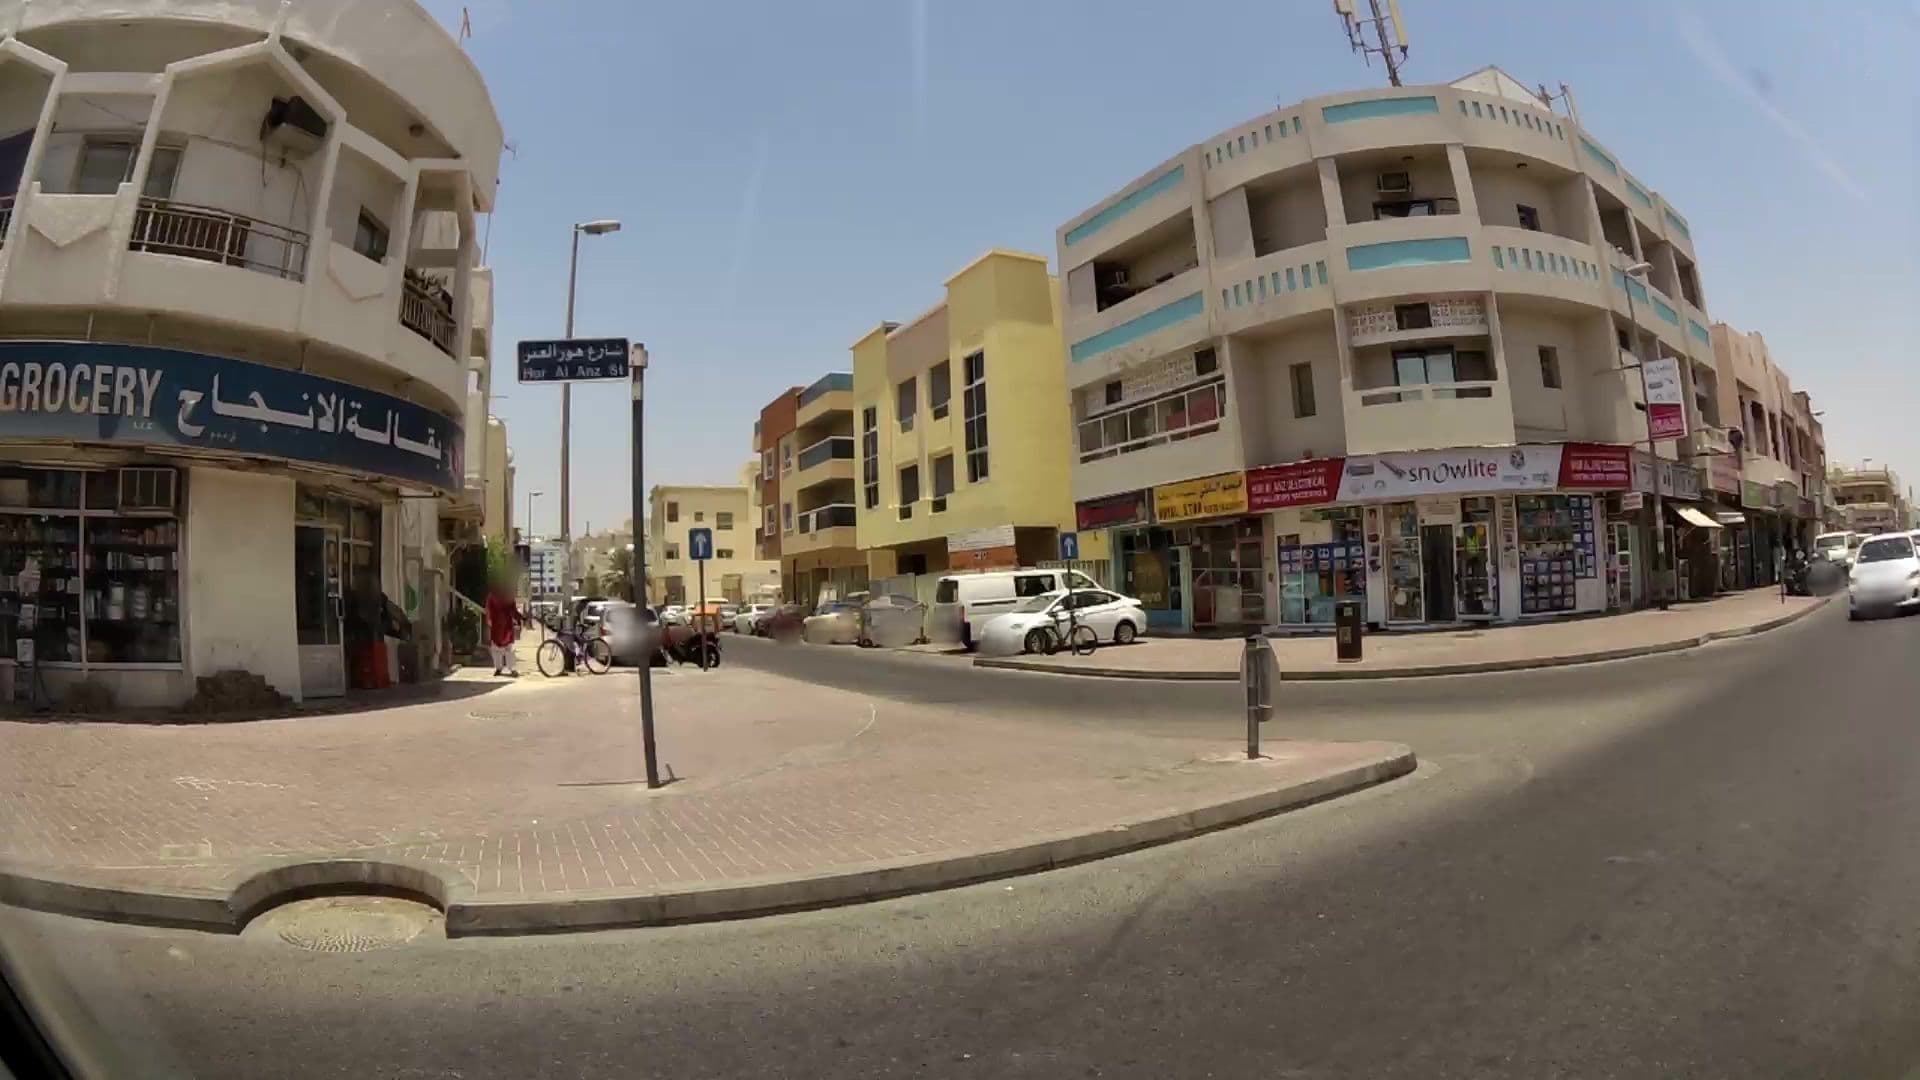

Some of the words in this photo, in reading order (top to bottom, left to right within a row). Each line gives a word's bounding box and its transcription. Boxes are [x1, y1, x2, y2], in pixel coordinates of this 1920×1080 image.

[557, 346, 584, 362] هور
[587, 344, 624, 362] شارع
[555, 365, 569, 378] Al
[576, 364, 602, 377] Anz
[609, 362, 625, 376] St
[0, 362, 163, 418] GROCERY
[177, 373, 346, 438] الانجاح
[345, 399, 442, 470] بقالة
[1408, 457, 1498, 484] snowlite
